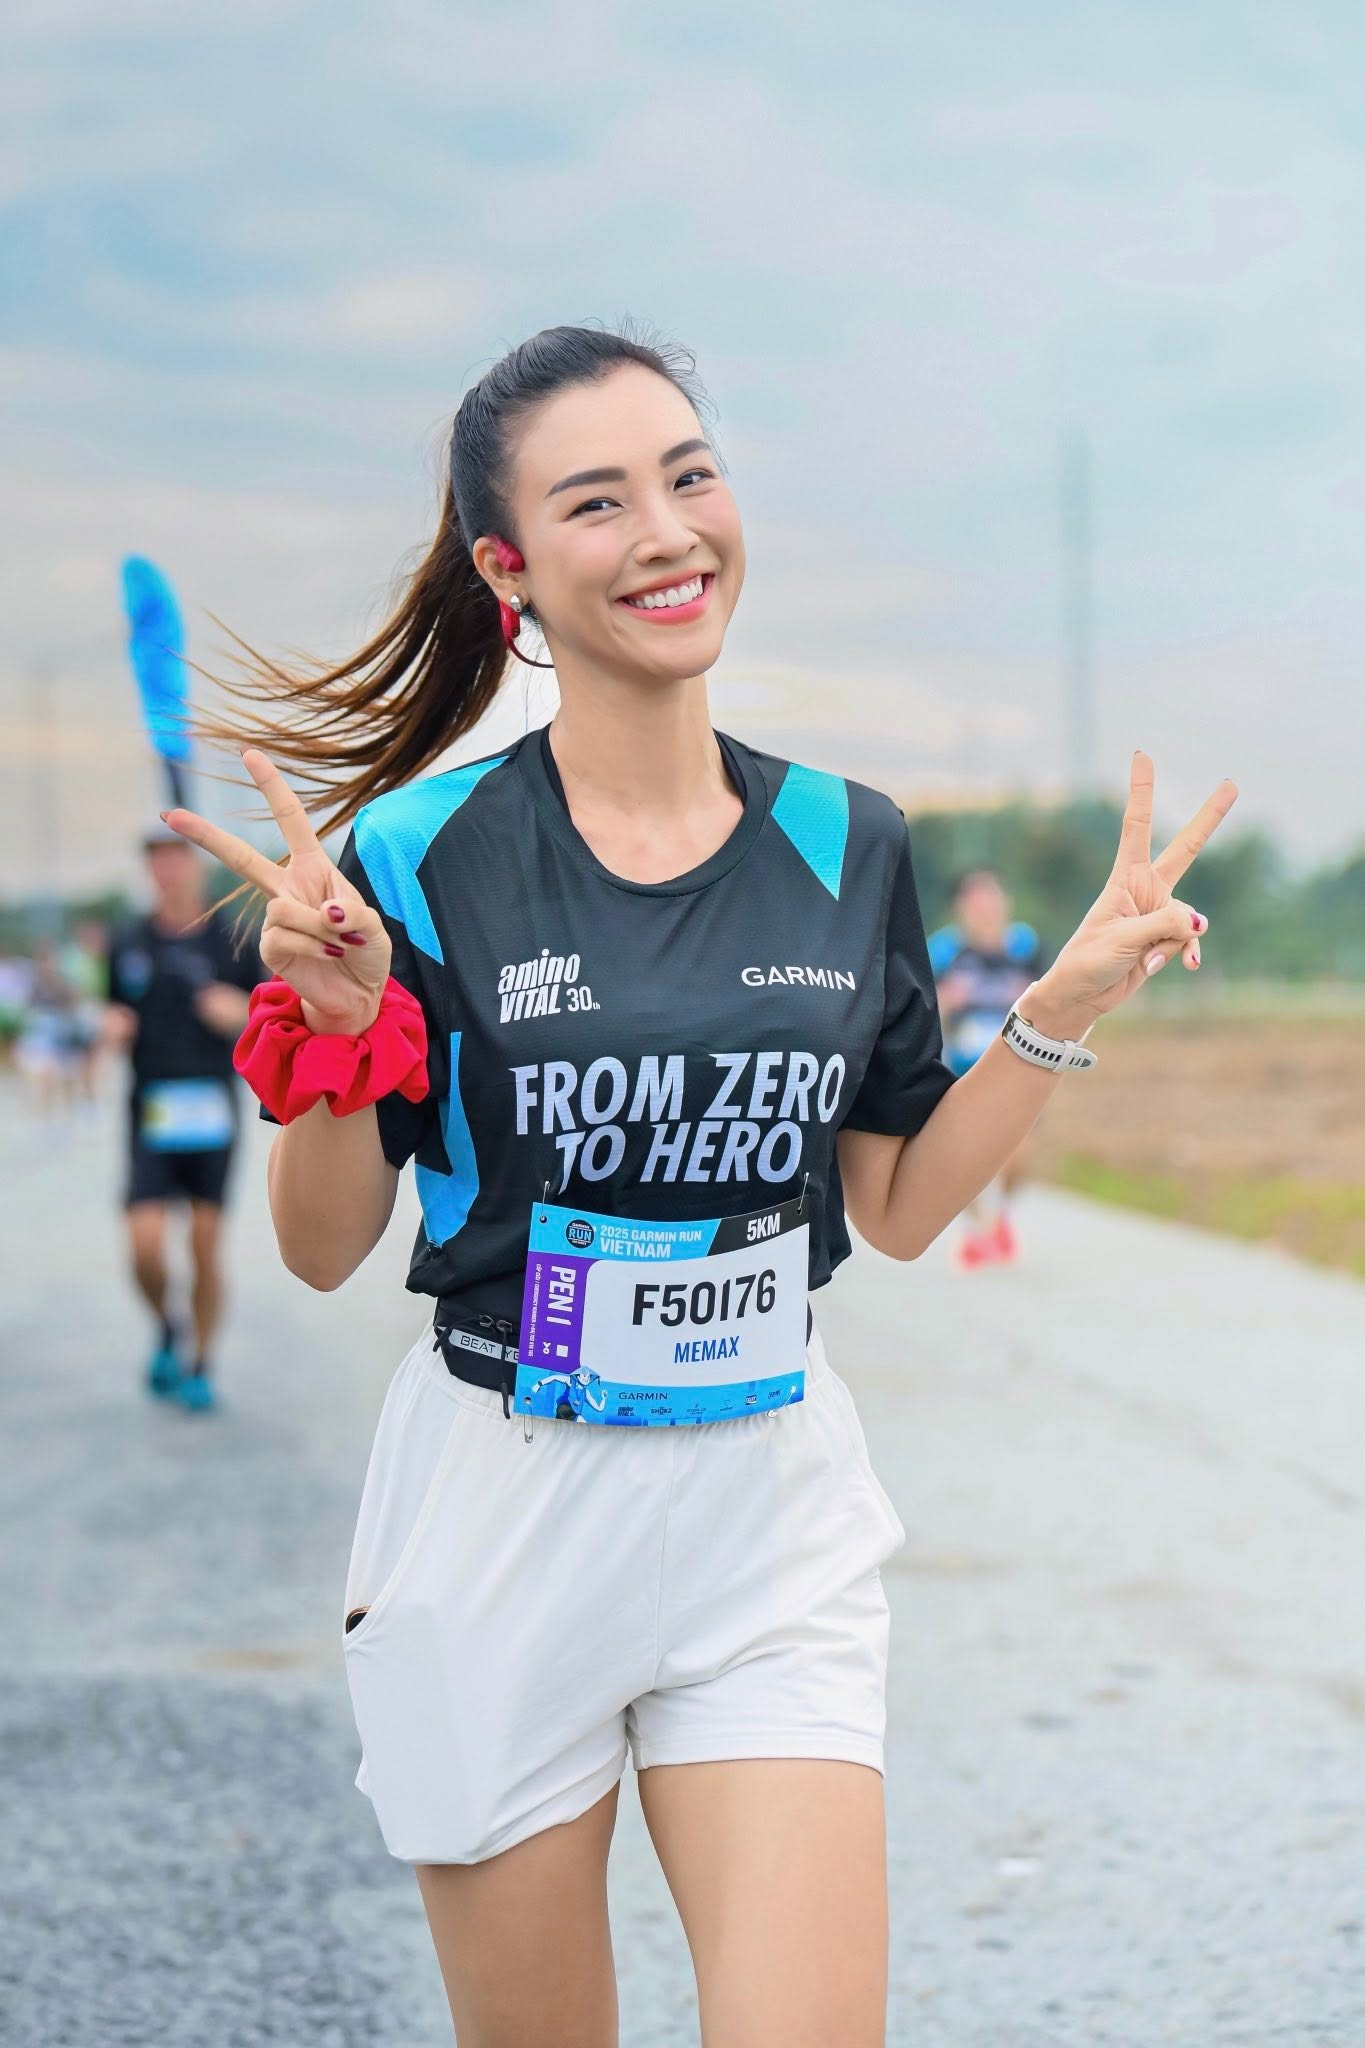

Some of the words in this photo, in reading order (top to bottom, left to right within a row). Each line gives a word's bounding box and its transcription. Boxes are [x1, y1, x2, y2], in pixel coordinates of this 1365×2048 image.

[498, 948, 580, 994] amino
[741, 966, 856, 990] GARMIN
[500, 984, 561, 1024] VITAL
[508, 1055, 685, 1135] FROM
[703, 1051, 846, 1123] ZERO
[555, 1124, 626, 1195] TO
[640, 1120, 803, 1183] HERO
[568, 1228, 592, 1241] RUN
[600, 1225, 629, 1239] 2025
[631, 1229, 676, 1242] GARMIN
[679, 1230, 702, 1242] RUN
[746, 1212, 781, 1242] 5KM
[600, 1238, 671, 1258] VIETNAM
[547, 1265, 577, 1313] PEN
[632, 1268, 776, 1327] F50176
[460, 1335, 496, 1354] BEAT
[674, 1335, 740, 1364] MEMAX
[618, 1391, 668, 1401] GARMIN
